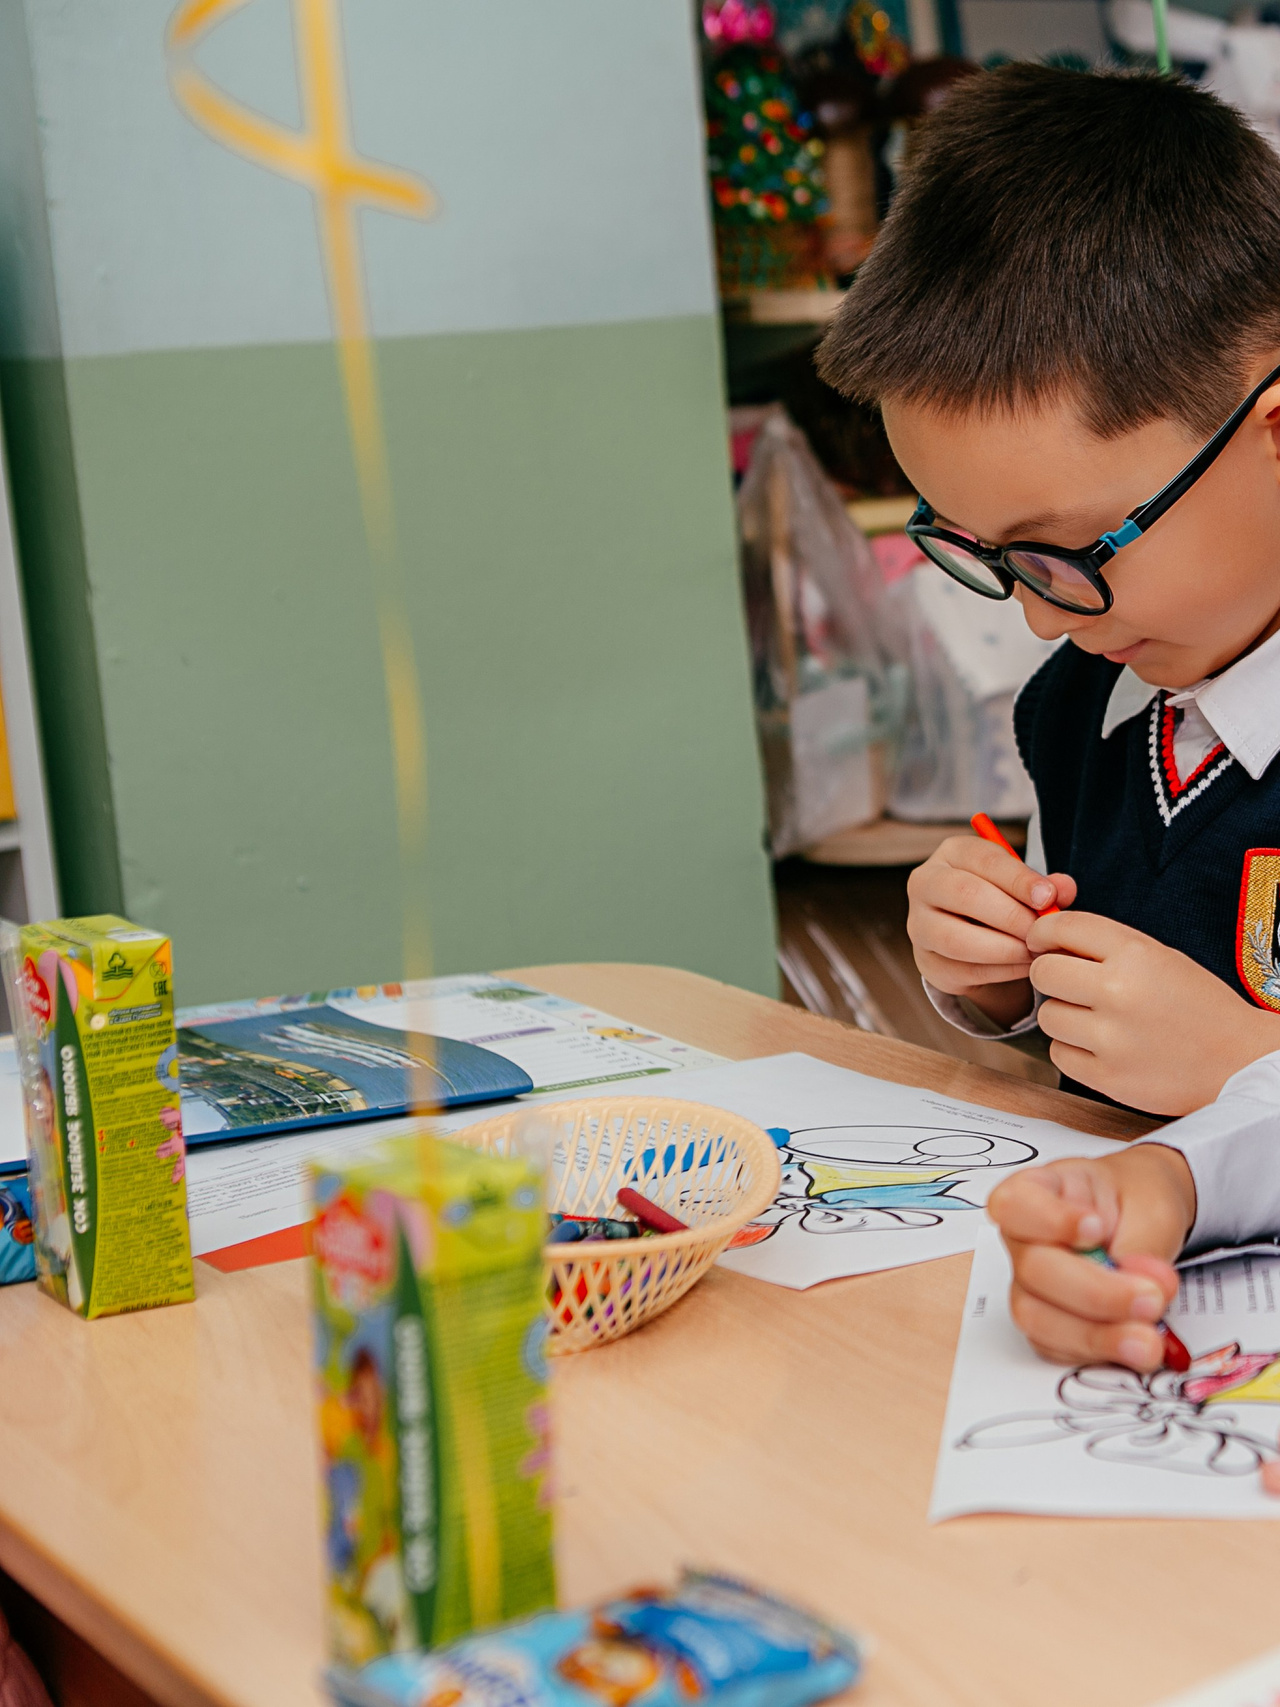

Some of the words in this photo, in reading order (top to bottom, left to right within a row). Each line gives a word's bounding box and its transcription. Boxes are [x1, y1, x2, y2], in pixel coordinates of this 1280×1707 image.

[60, 1045, 78, 1117] ЯБЛОКО
[66, 1120, 85, 1194] ЗЕЛЁНОЕ
[72, 1198, 88, 1235] СОК
